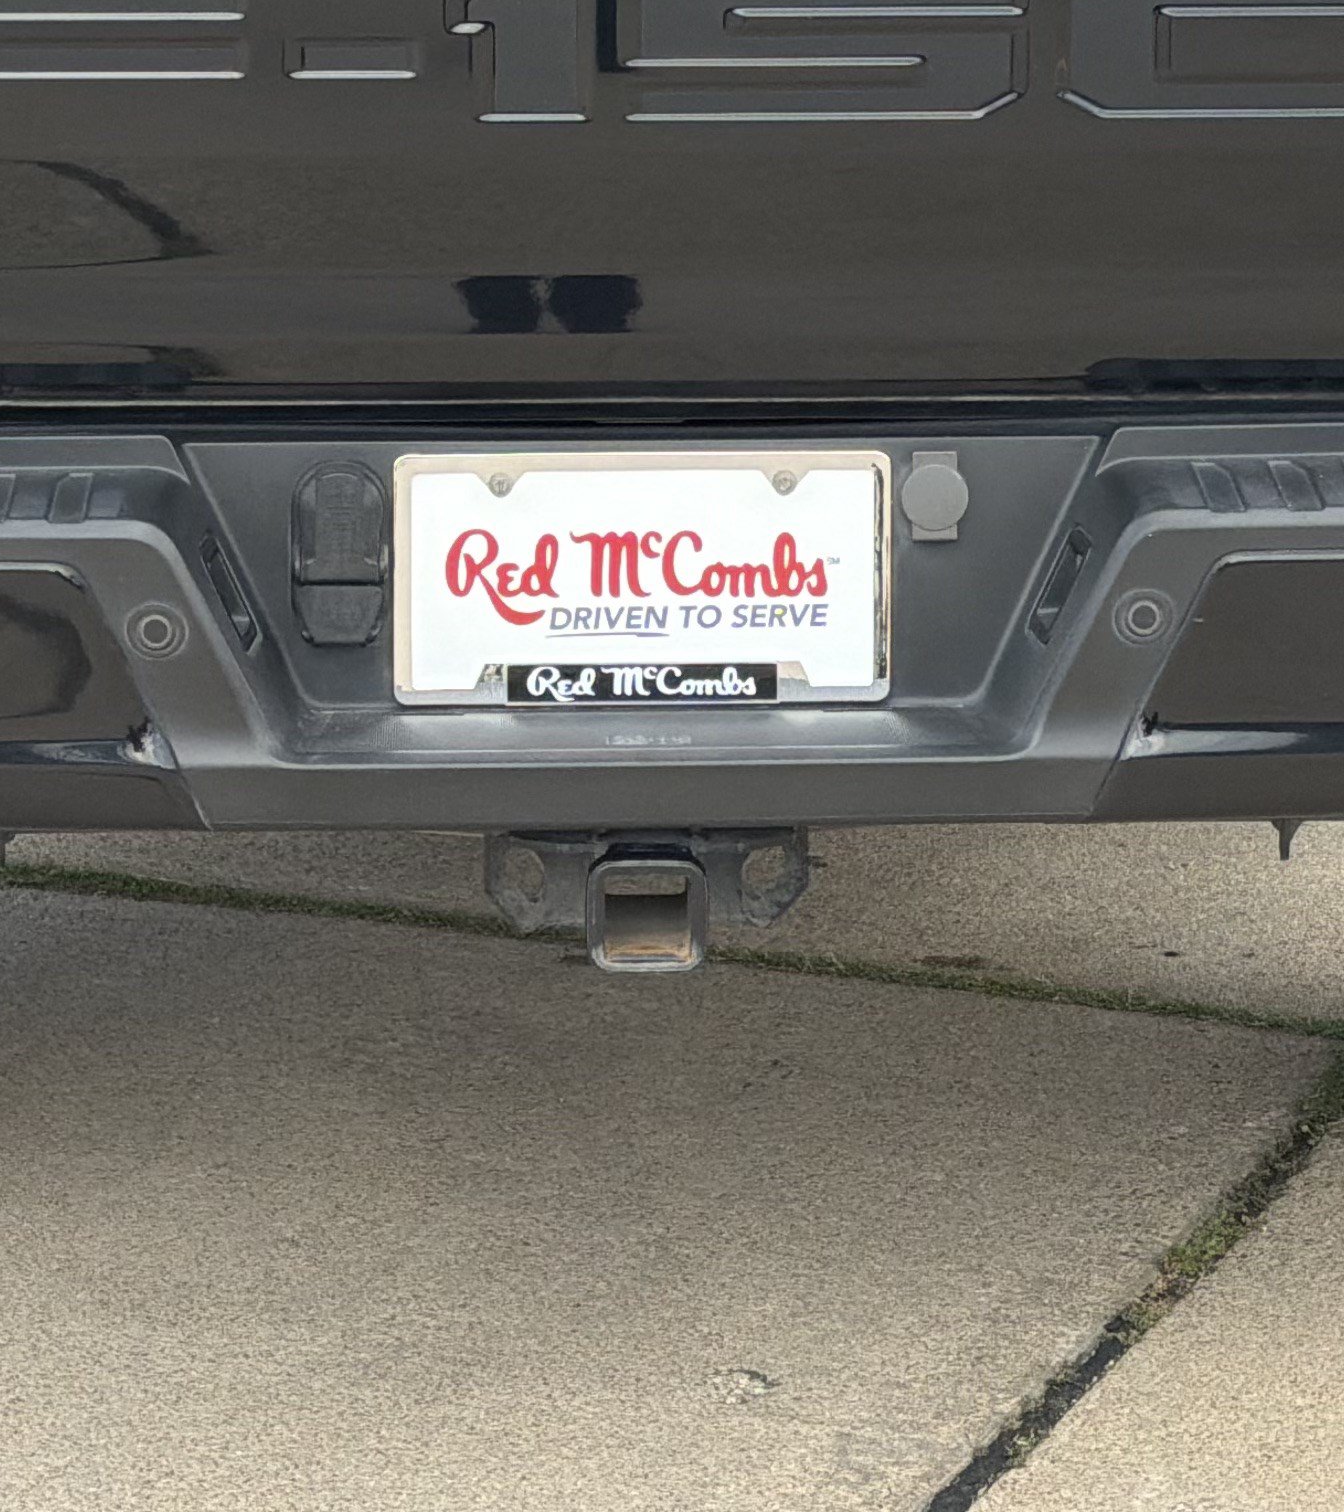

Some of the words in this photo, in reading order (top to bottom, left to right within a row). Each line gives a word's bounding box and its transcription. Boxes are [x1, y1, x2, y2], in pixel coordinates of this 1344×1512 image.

[445, 529, 559, 625] Red
[569, 530, 829, 598] McCombs
[549, 605, 669, 631] DRIVEN
[679, 604, 723, 628] TO
[731, 603, 829, 628] SERVE
[526, 666, 596, 702] Red
[601, 666, 757, 697] McCombs
